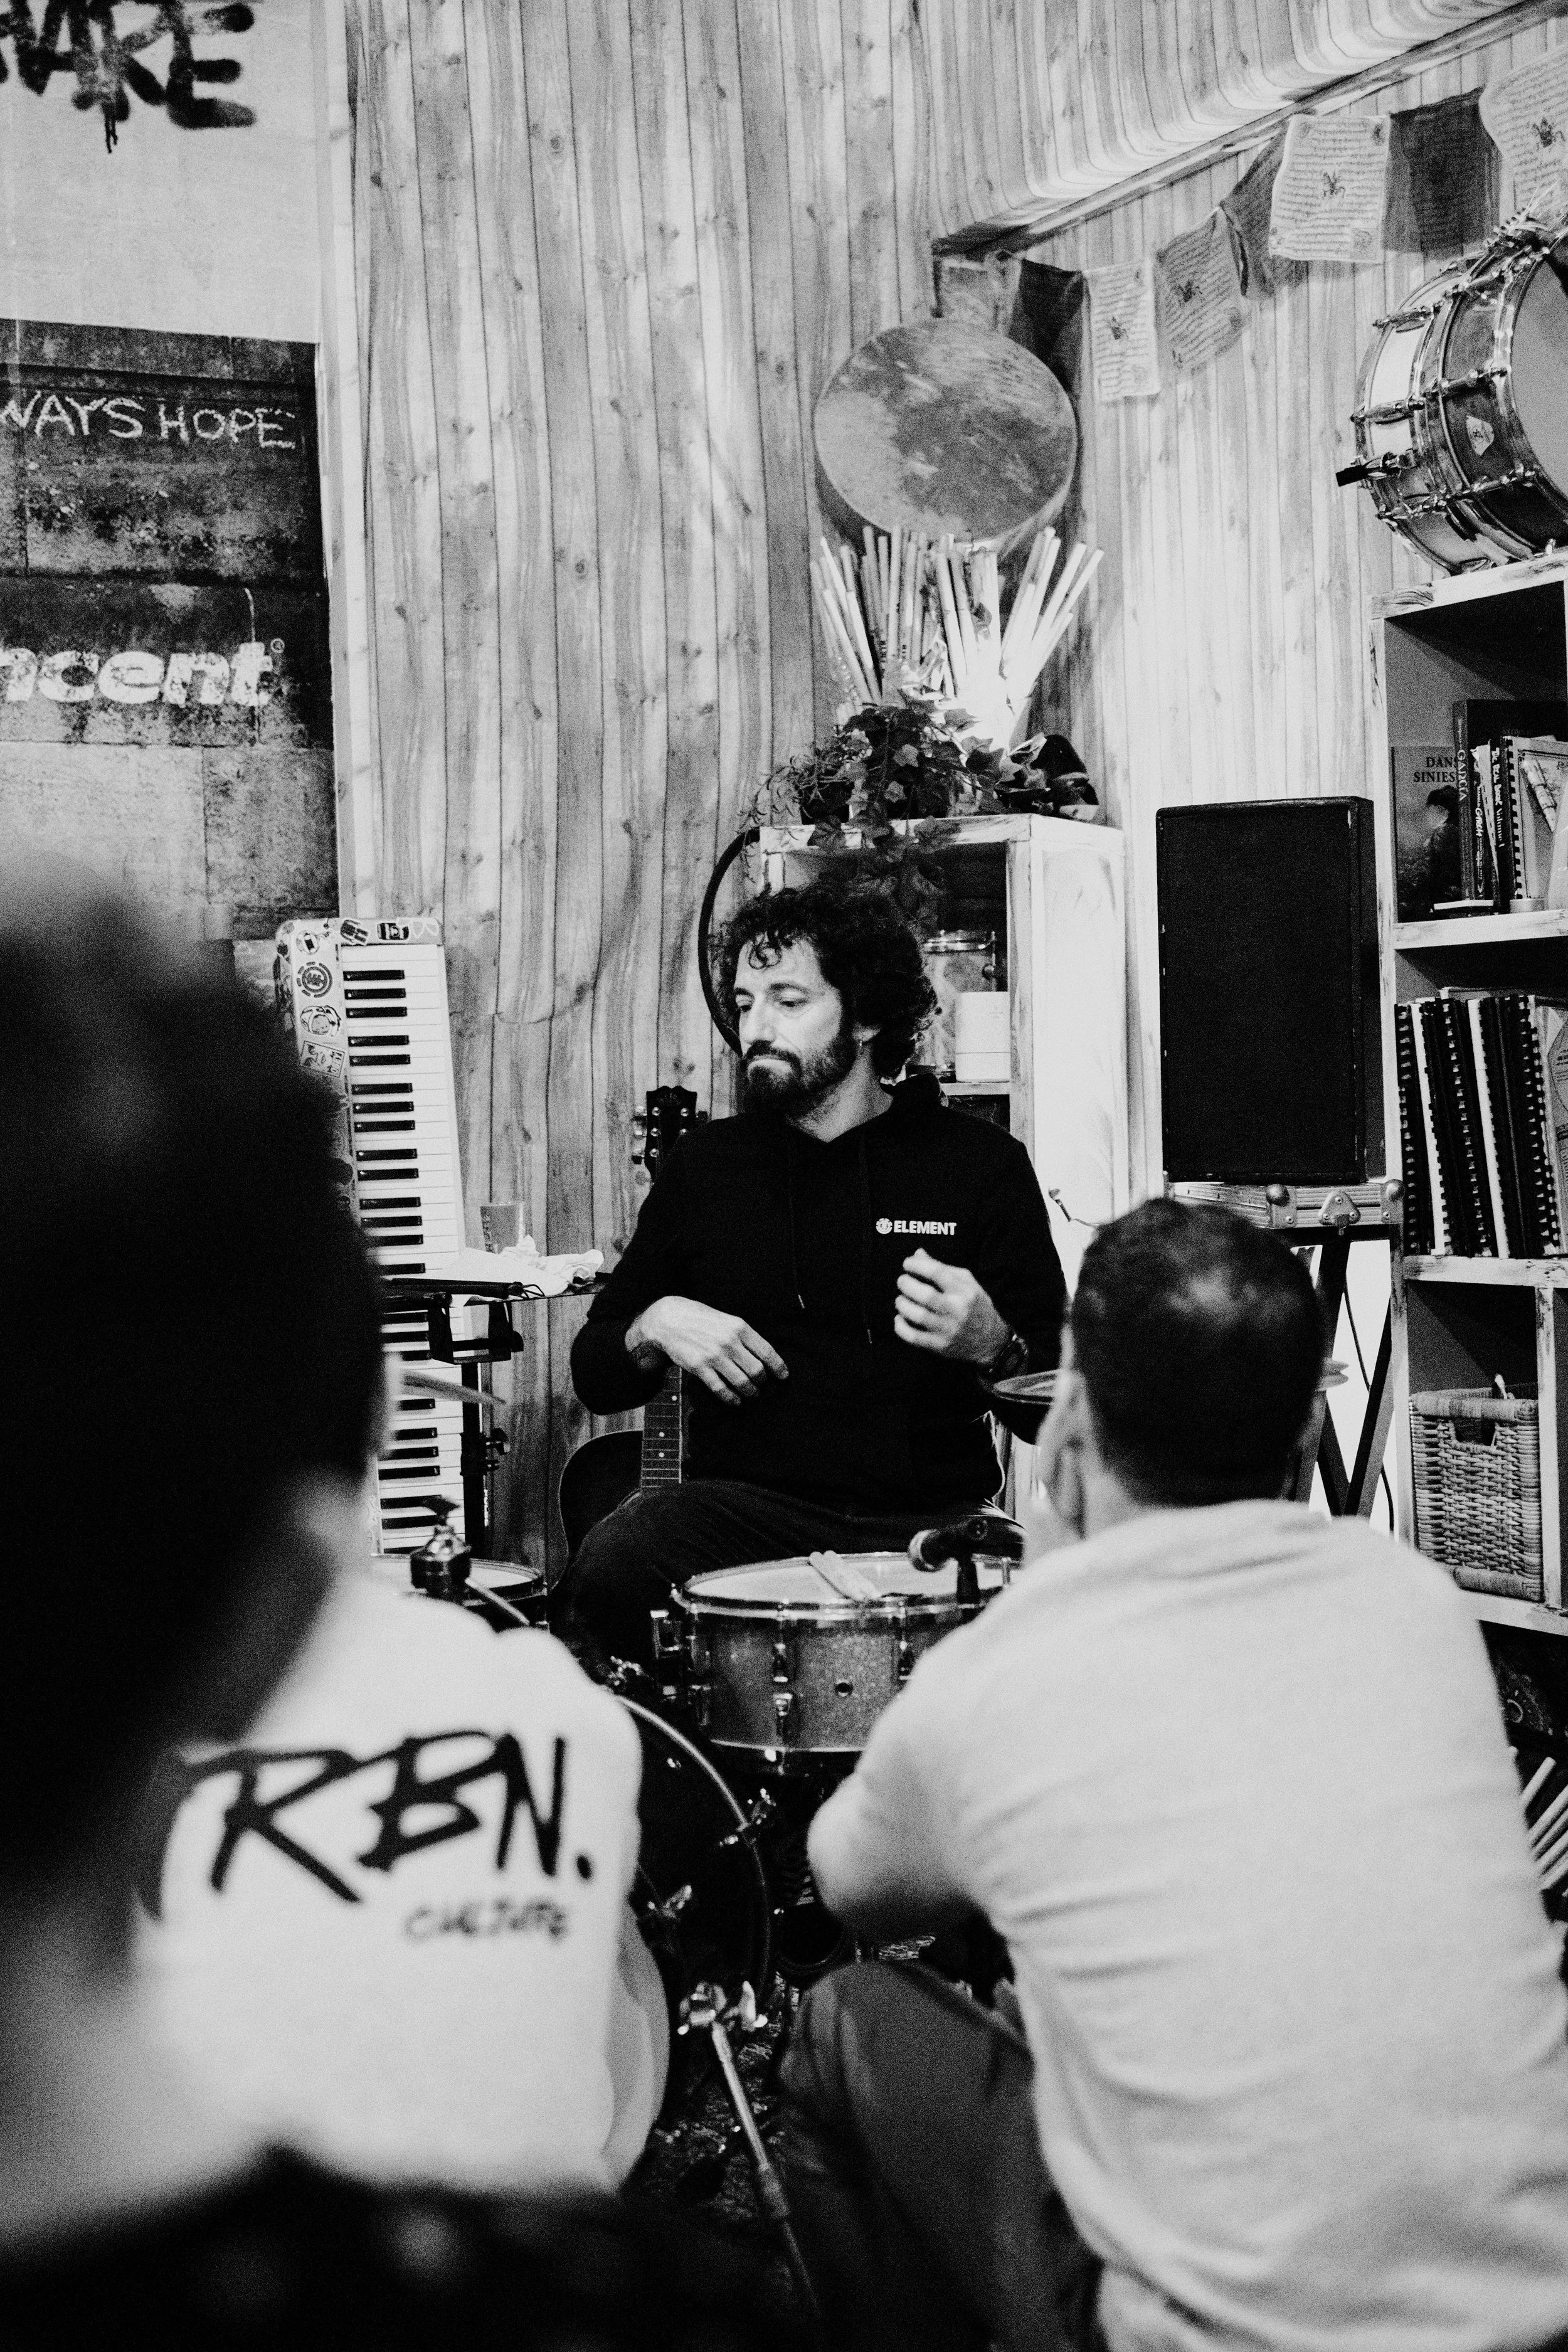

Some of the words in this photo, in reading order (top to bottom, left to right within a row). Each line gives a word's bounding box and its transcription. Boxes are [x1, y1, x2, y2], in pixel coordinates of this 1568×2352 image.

[156, 398, 295, 448] HOPE
[1426, 756, 1457, 768] DAN
[894, 1220, 957, 1236] ELEMENT
